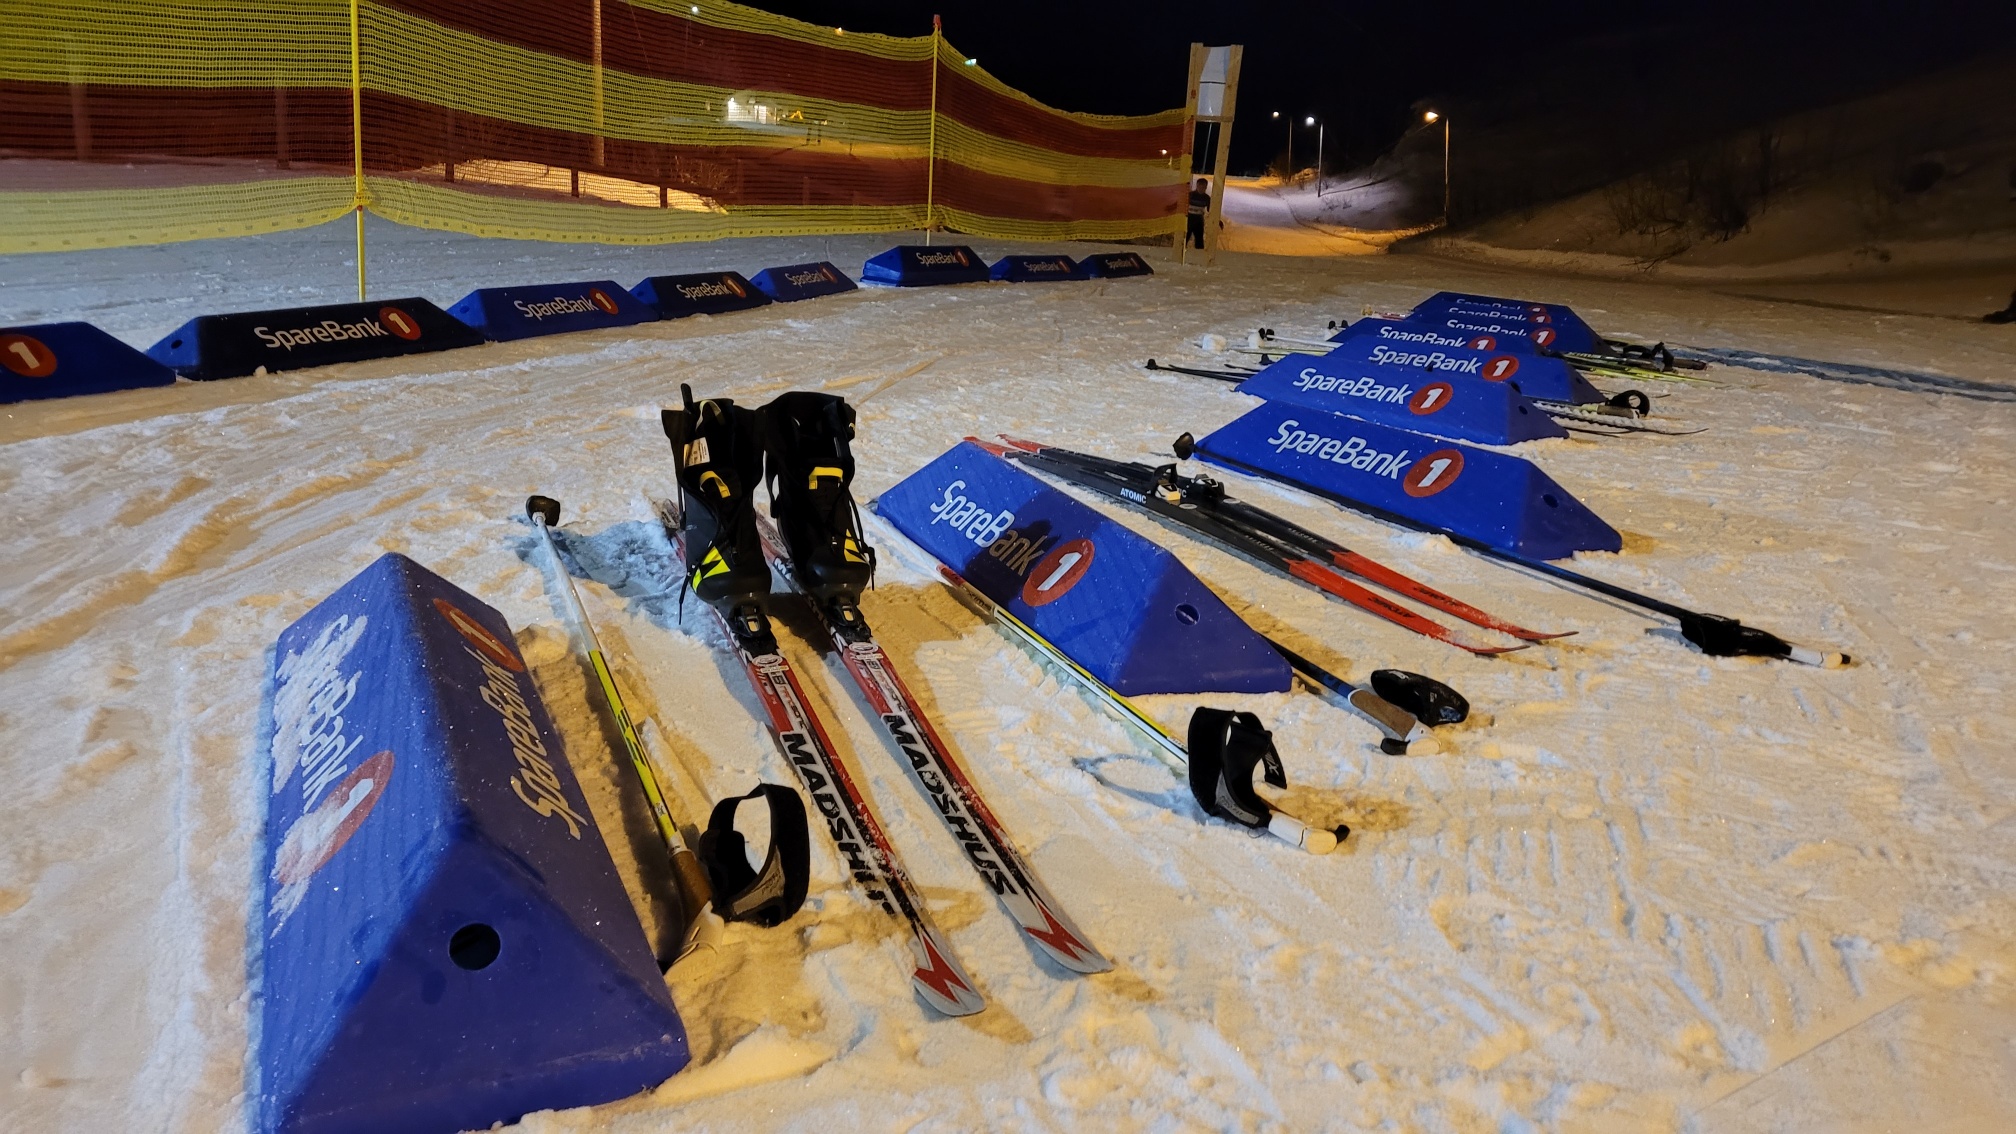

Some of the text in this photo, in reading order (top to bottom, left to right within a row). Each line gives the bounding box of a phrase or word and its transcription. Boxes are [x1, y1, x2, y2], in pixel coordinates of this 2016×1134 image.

[916, 252, 959, 267] SpareBank
[676, 284, 733, 301] SpareBank
[784, 271, 827, 287] SpareBank
[513, 292, 611, 321] SpareBank 1
[253, 310, 413, 351] SpareBank 1
[7, 340, 43, 371] 1
[1368, 345, 1511, 377] SpareBank 1
[1292, 366, 1445, 409] SpareBank 1
[1266, 419, 1453, 489] SpareBank 1
[1119, 487, 1148, 505] ATOMIC
[929, 479, 1082, 593] SpareBank 1
[449, 610, 588, 841] SpareBank 1
[882, 713, 1019, 897] MADSHUS
